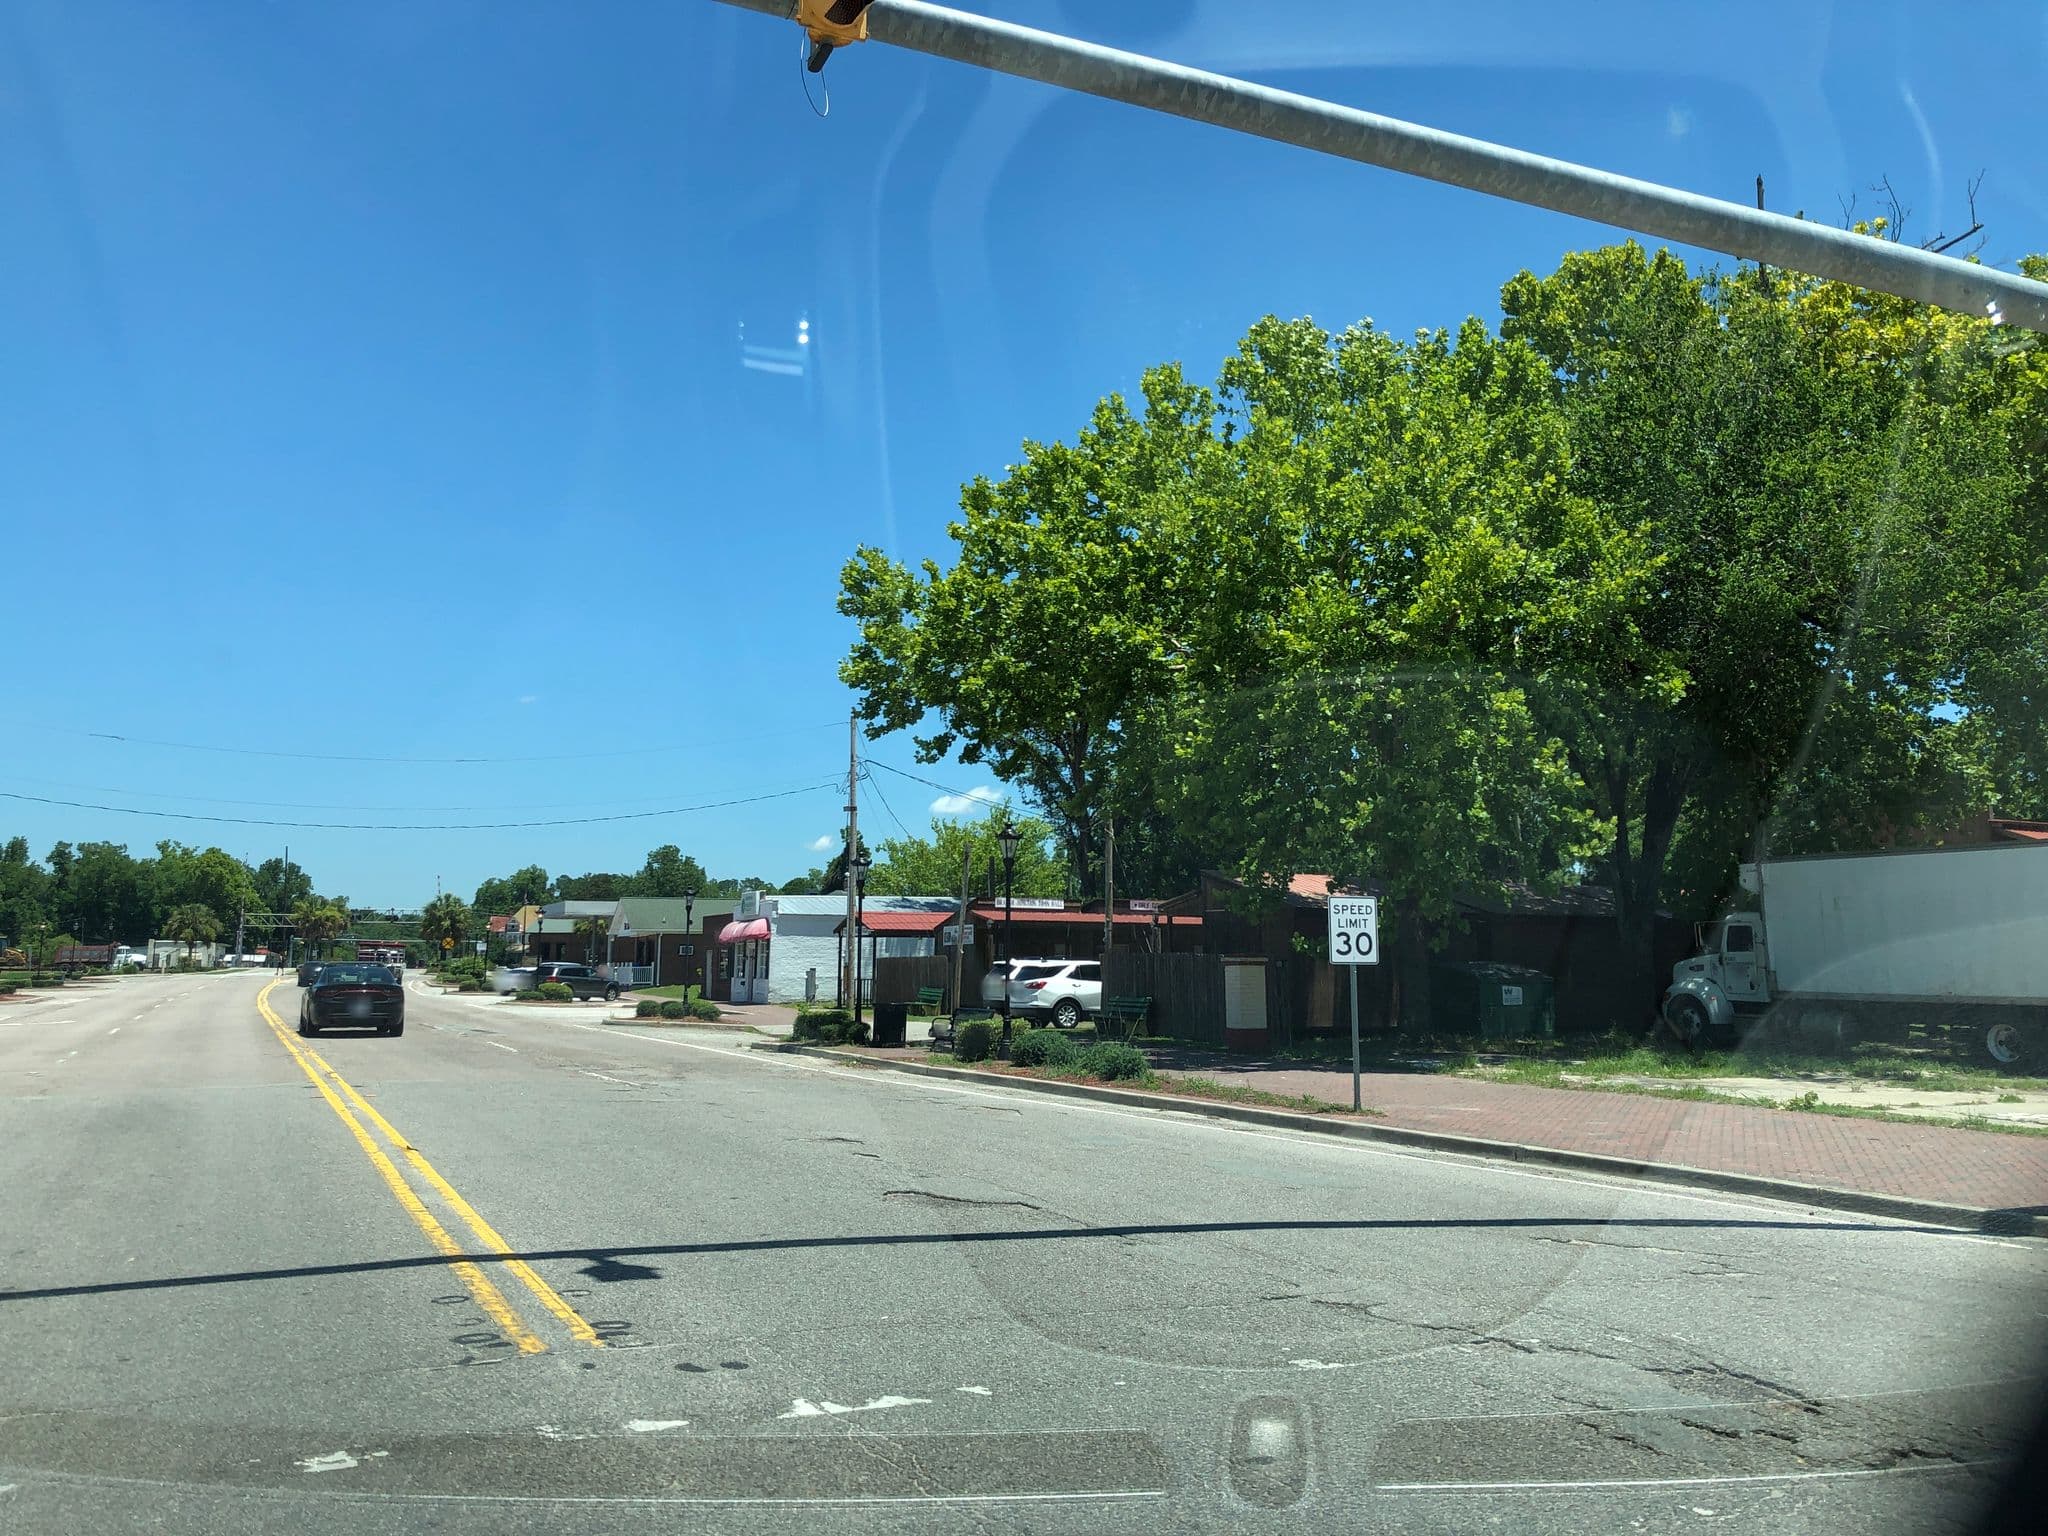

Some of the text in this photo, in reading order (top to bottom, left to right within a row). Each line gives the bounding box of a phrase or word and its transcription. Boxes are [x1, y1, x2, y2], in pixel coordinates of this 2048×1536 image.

[1333, 904, 1373, 915] SPEED
[1337, 918, 1369, 929] LIMIT
[1336, 931, 1373, 956] 30
